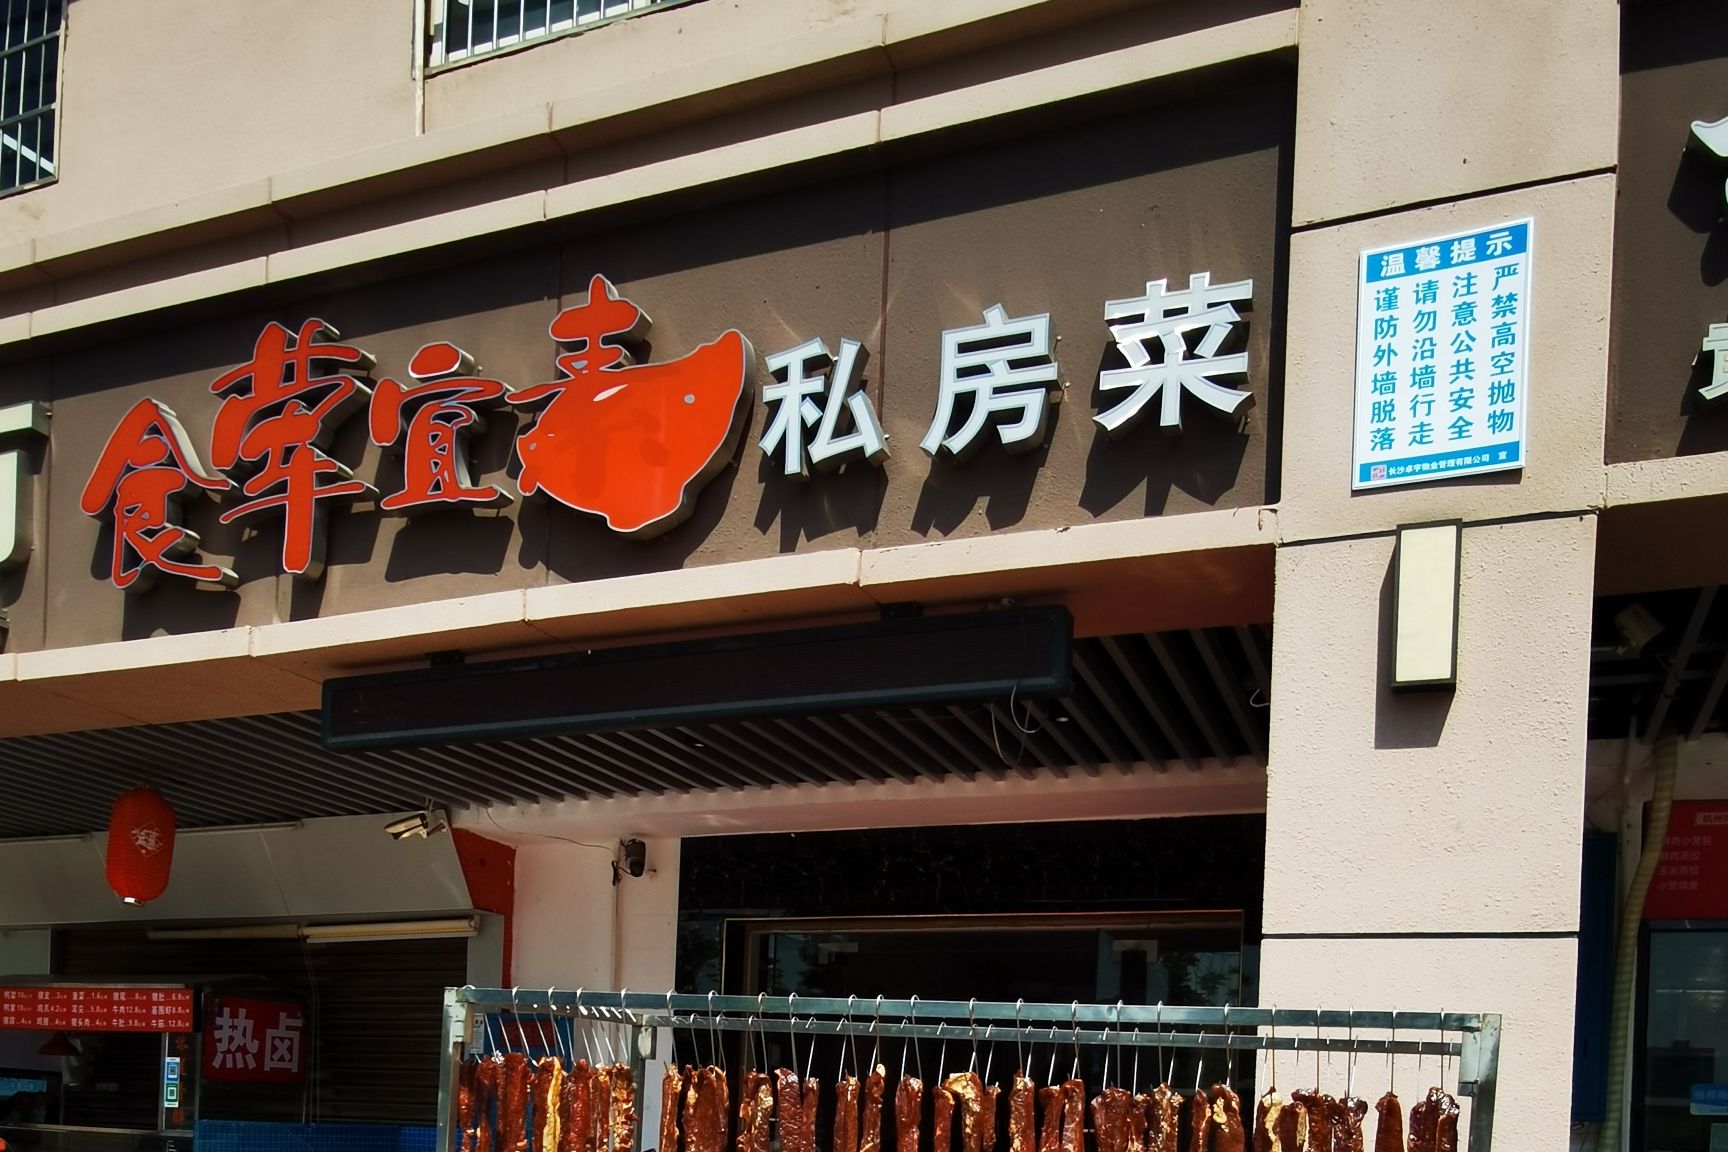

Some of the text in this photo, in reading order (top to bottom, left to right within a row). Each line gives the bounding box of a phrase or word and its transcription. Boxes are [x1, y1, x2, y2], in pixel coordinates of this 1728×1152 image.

[1380, 230, 1513, 278] 温馨提示
[760, 272, 1255, 477] 私房菜
[1370, 286, 1400, 452] 谨防外墙脱落
[1408, 279, 1439, 447] 请勿沿墙行走
[1447, 272, 1478, 442] 注意公共安全
[1487, 263, 1519, 435] 严禁高空抛物
[212, 1007, 304, 1073] 热卤
